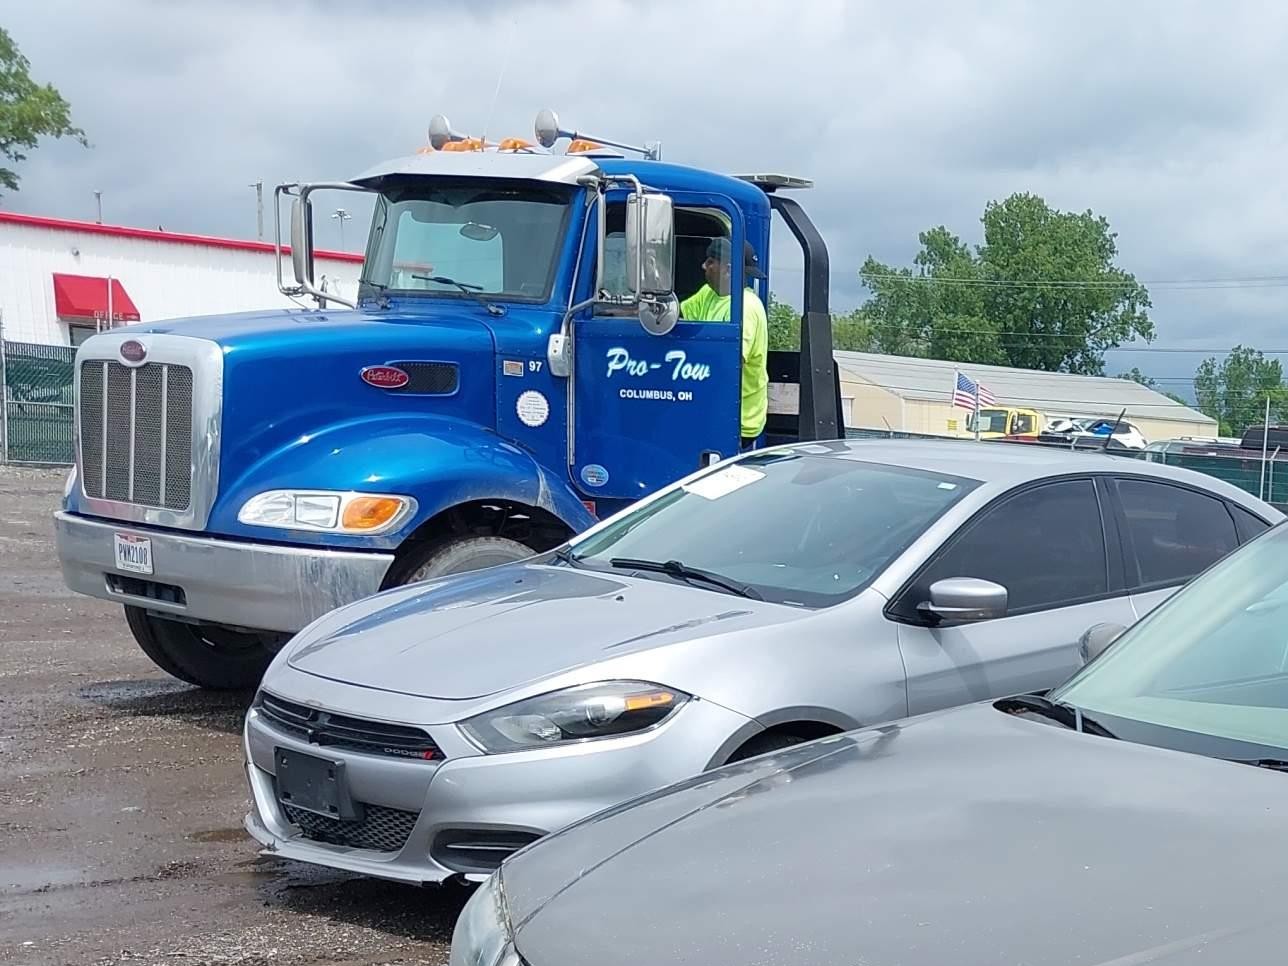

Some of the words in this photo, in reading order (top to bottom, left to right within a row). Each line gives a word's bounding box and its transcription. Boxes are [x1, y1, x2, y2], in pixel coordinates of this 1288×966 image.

[528, 360, 543, 372] 97
[619, 388, 676, 402] COLUMBUS,
[677, 391, 693, 401] OH
